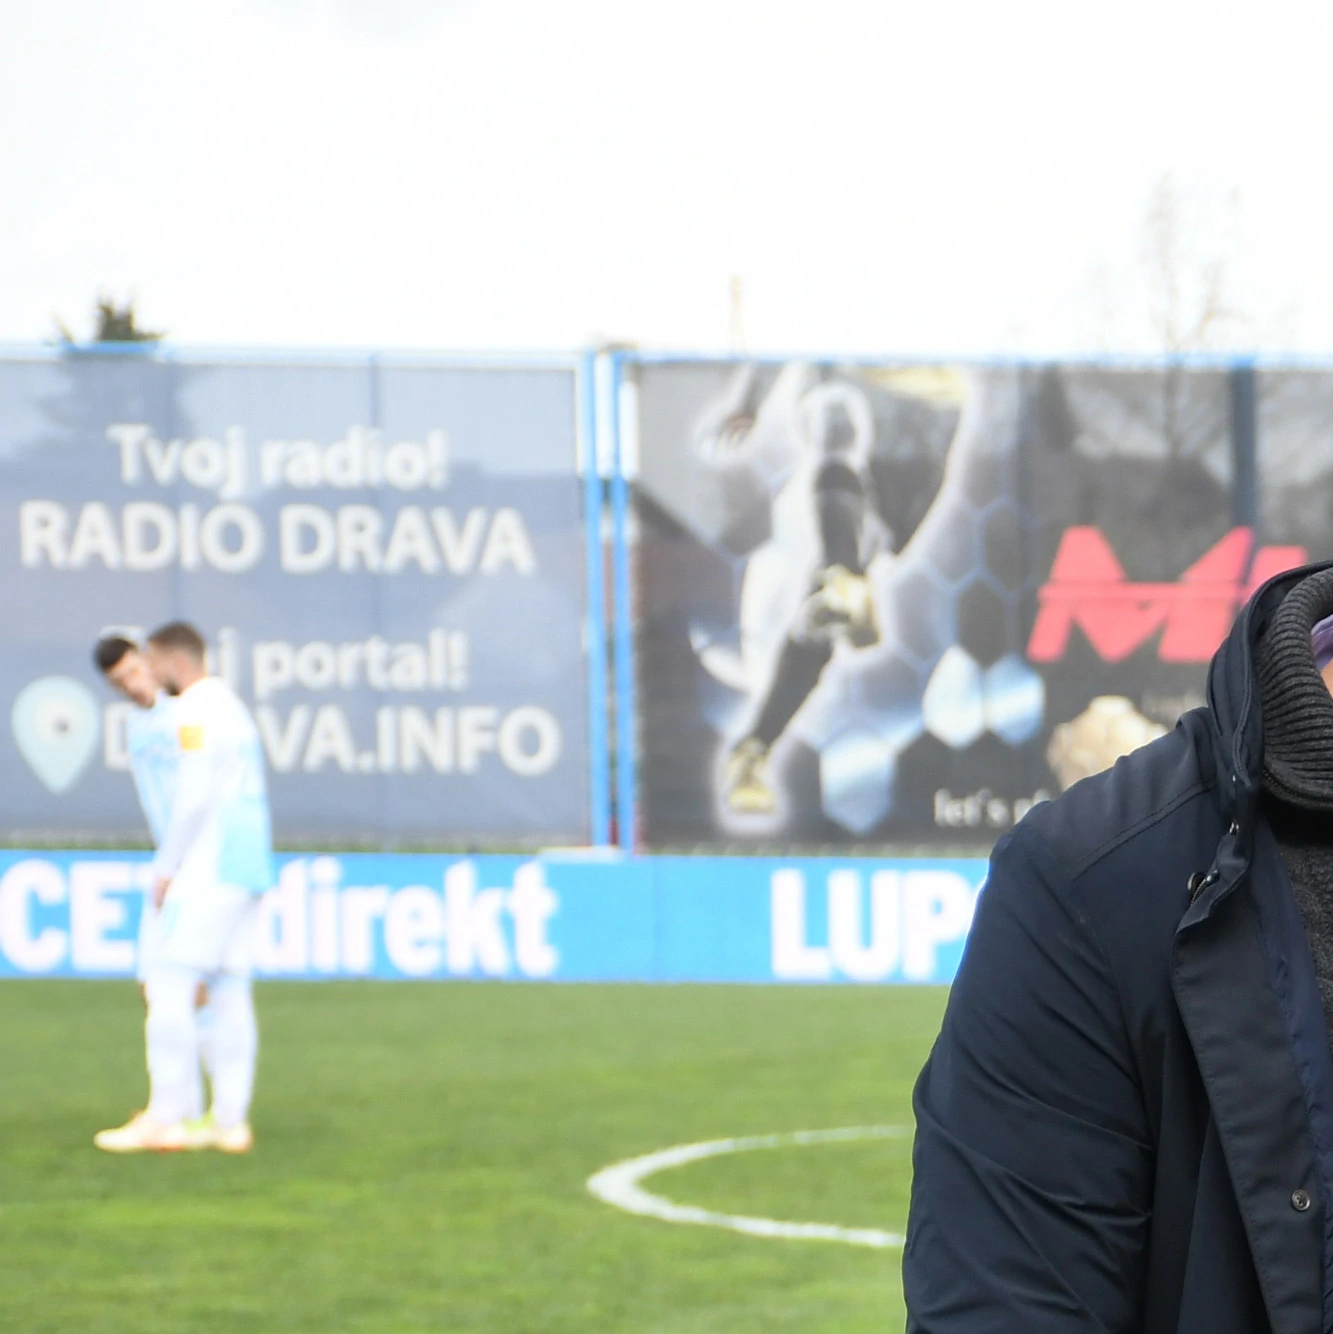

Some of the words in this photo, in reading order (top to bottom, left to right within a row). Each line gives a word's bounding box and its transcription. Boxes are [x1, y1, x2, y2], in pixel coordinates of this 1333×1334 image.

[108, 424, 248, 498] Tvoj
[261, 422, 450, 489] radio!
[20, 501, 263, 572] RADIO
[280, 503, 536, 574] DRAVA
[254, 630, 468, 699] portal!
[254, 855, 558, 978] direkt
[770, 868, 984, 981] LUP
